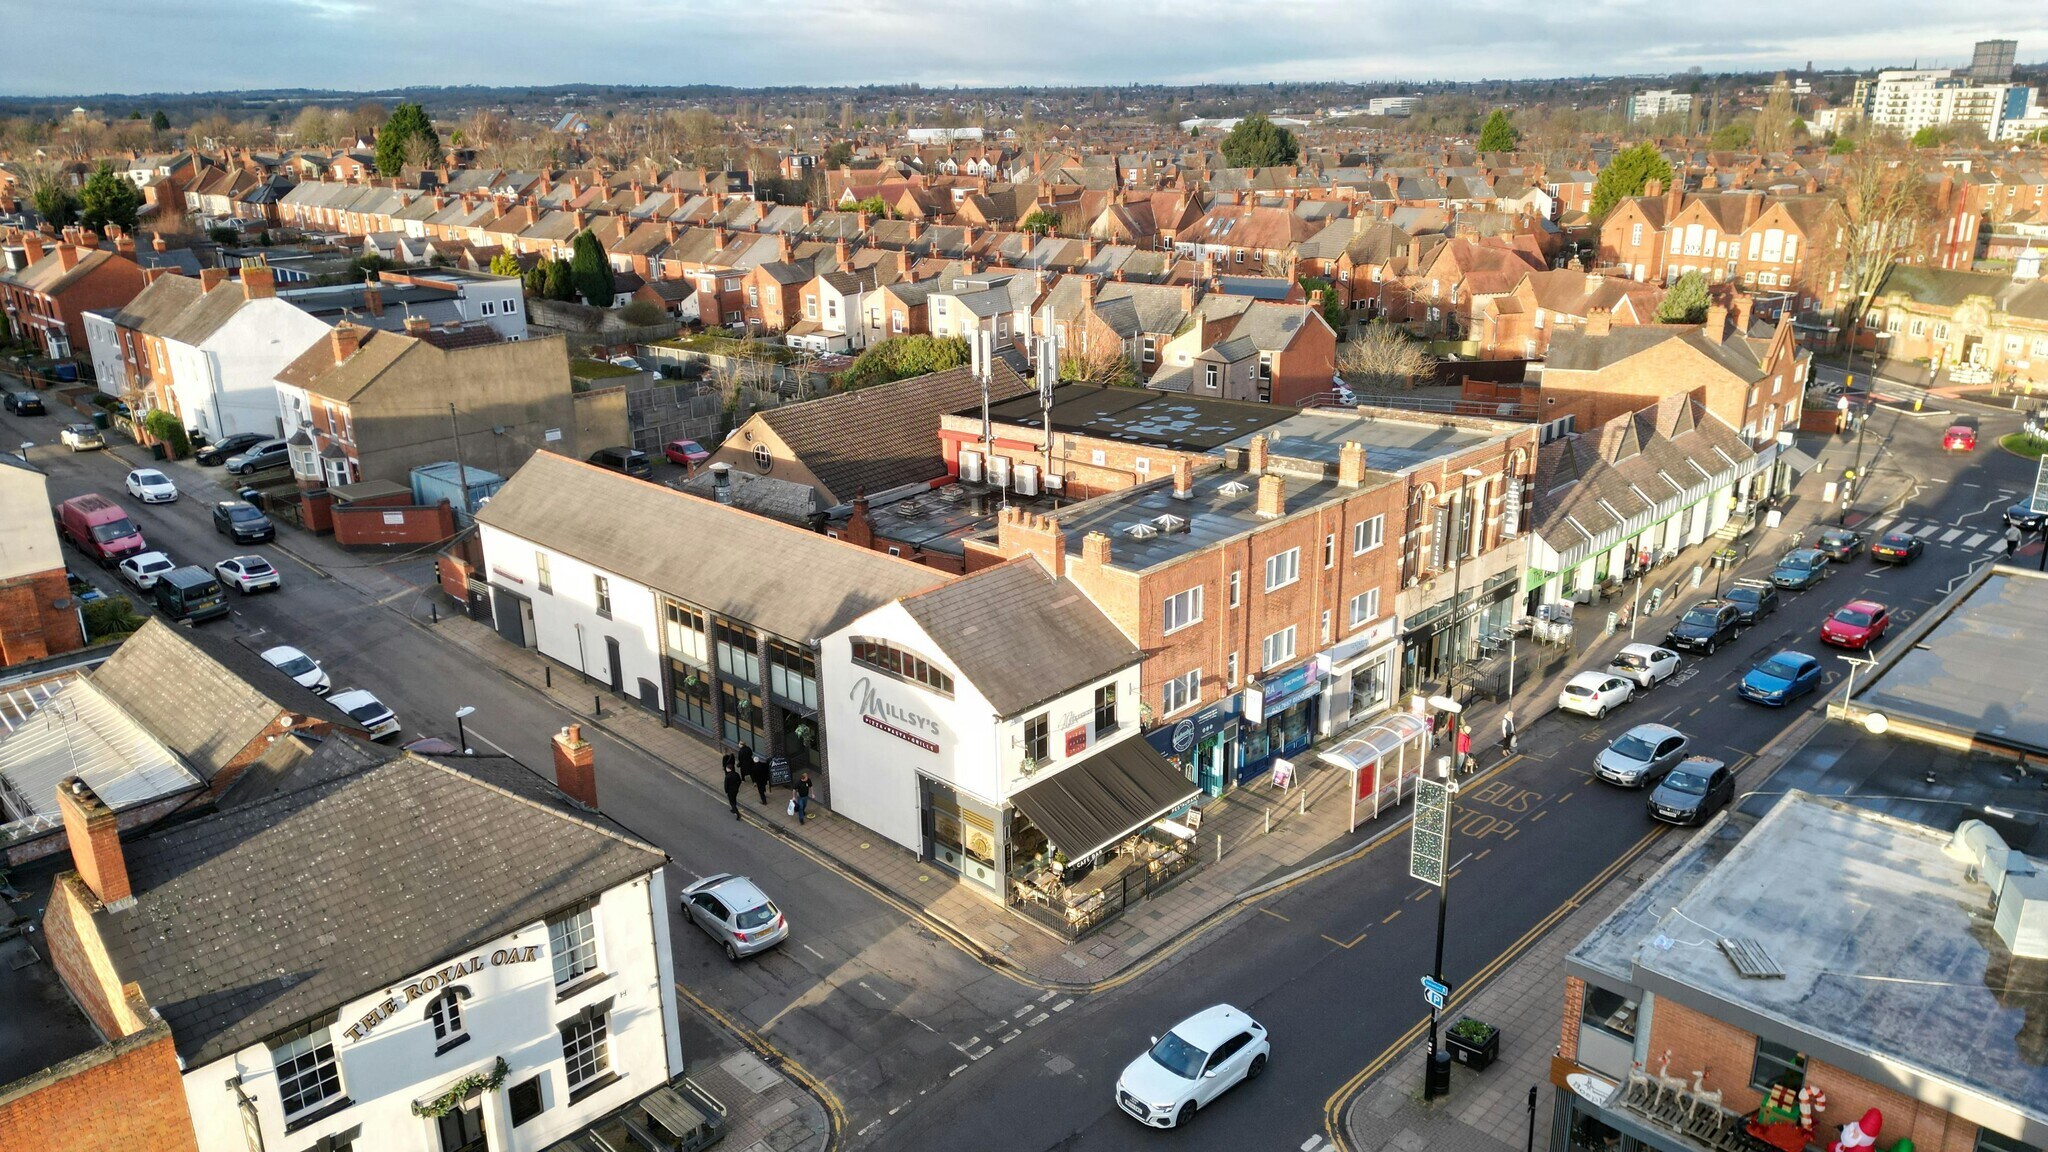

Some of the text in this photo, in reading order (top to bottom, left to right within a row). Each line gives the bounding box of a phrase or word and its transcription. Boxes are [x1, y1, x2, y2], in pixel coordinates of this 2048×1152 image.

[865, 718, 884, 731] PIZZA
[887, 727, 907, 740] PASTA
[1472, 781, 1542, 812] BUS
[343, 945, 539, 1043] THE ROYAL OAK
